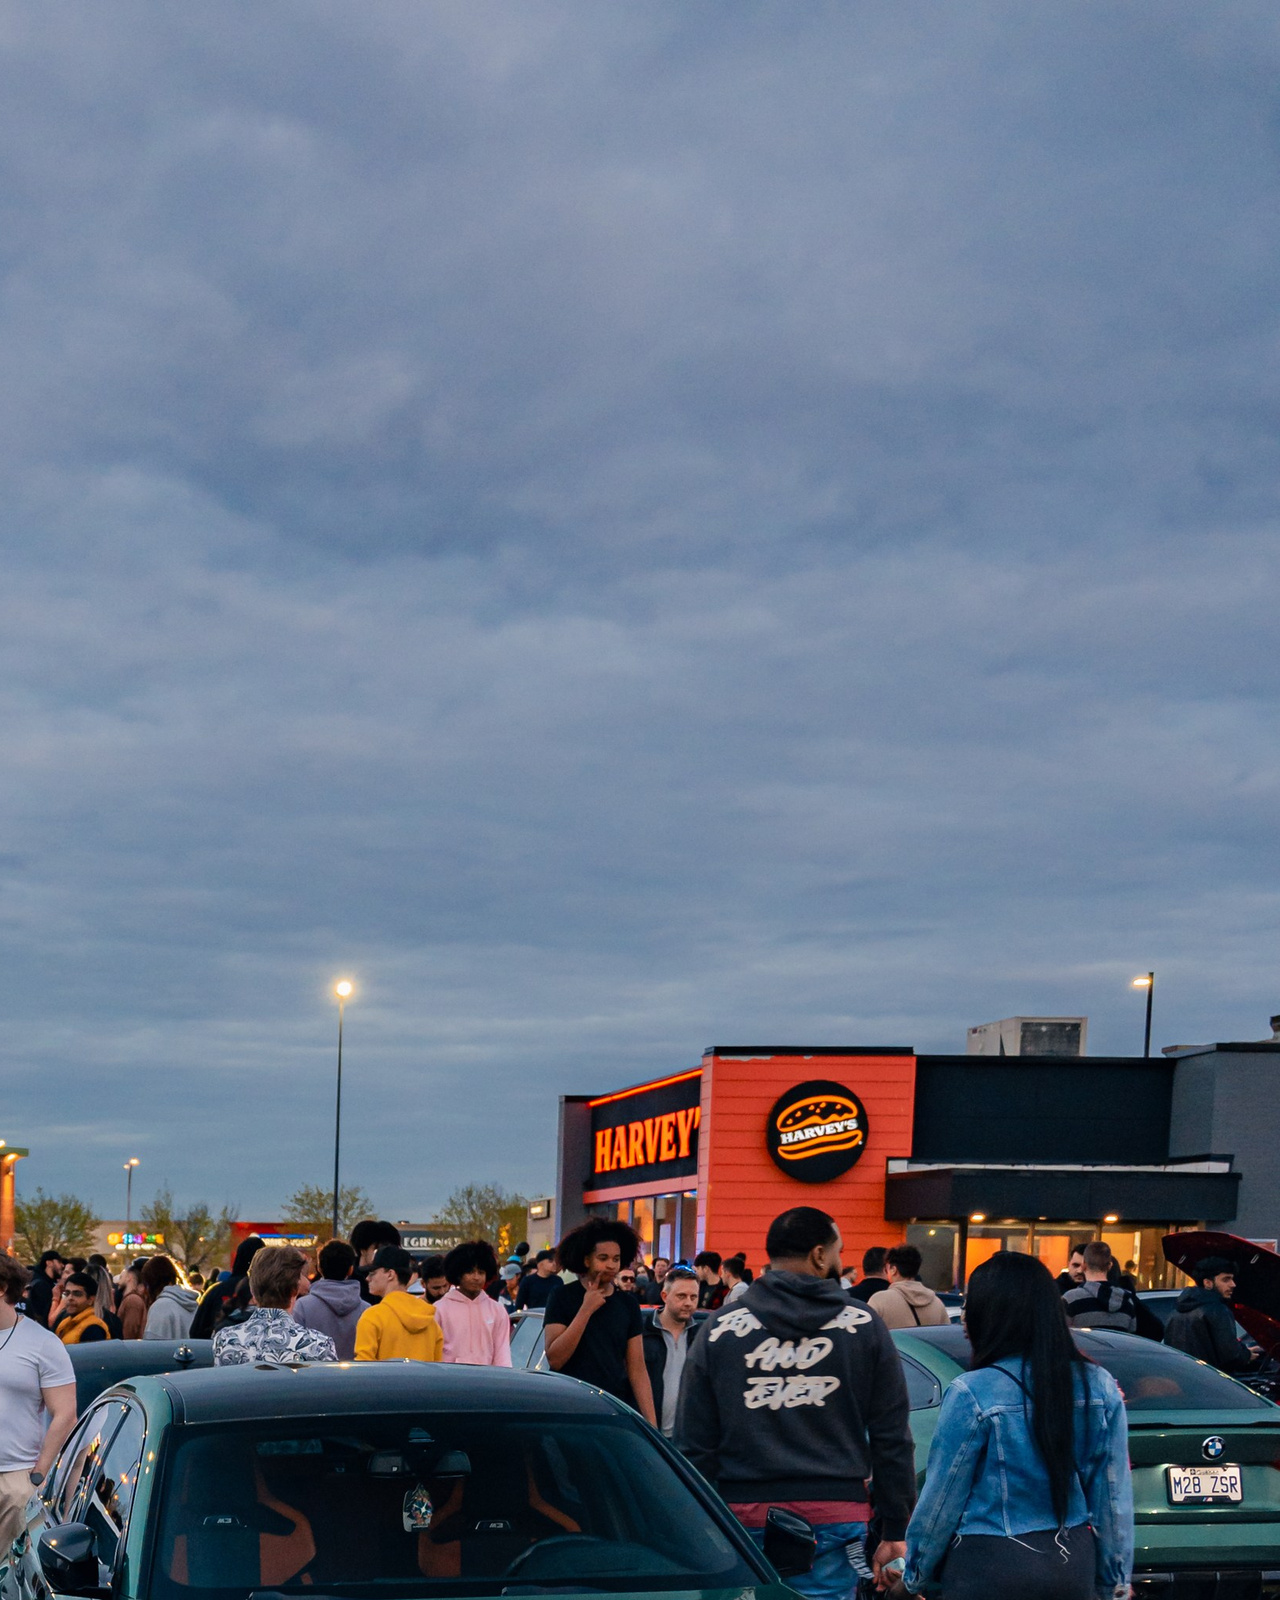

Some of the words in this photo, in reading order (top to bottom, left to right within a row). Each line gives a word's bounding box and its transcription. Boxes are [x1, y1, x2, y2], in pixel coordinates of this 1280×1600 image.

[595, 1106, 701, 1173] HARVEY'
[780, 1118, 858, 1144] HARVEY'S
[744, 1337, 833, 1371] AND
[743, 1374, 841, 1410] EVER
[1173, 1476, 1201, 1494] M28
[1210, 1475, 1238, 1493] ZSR
